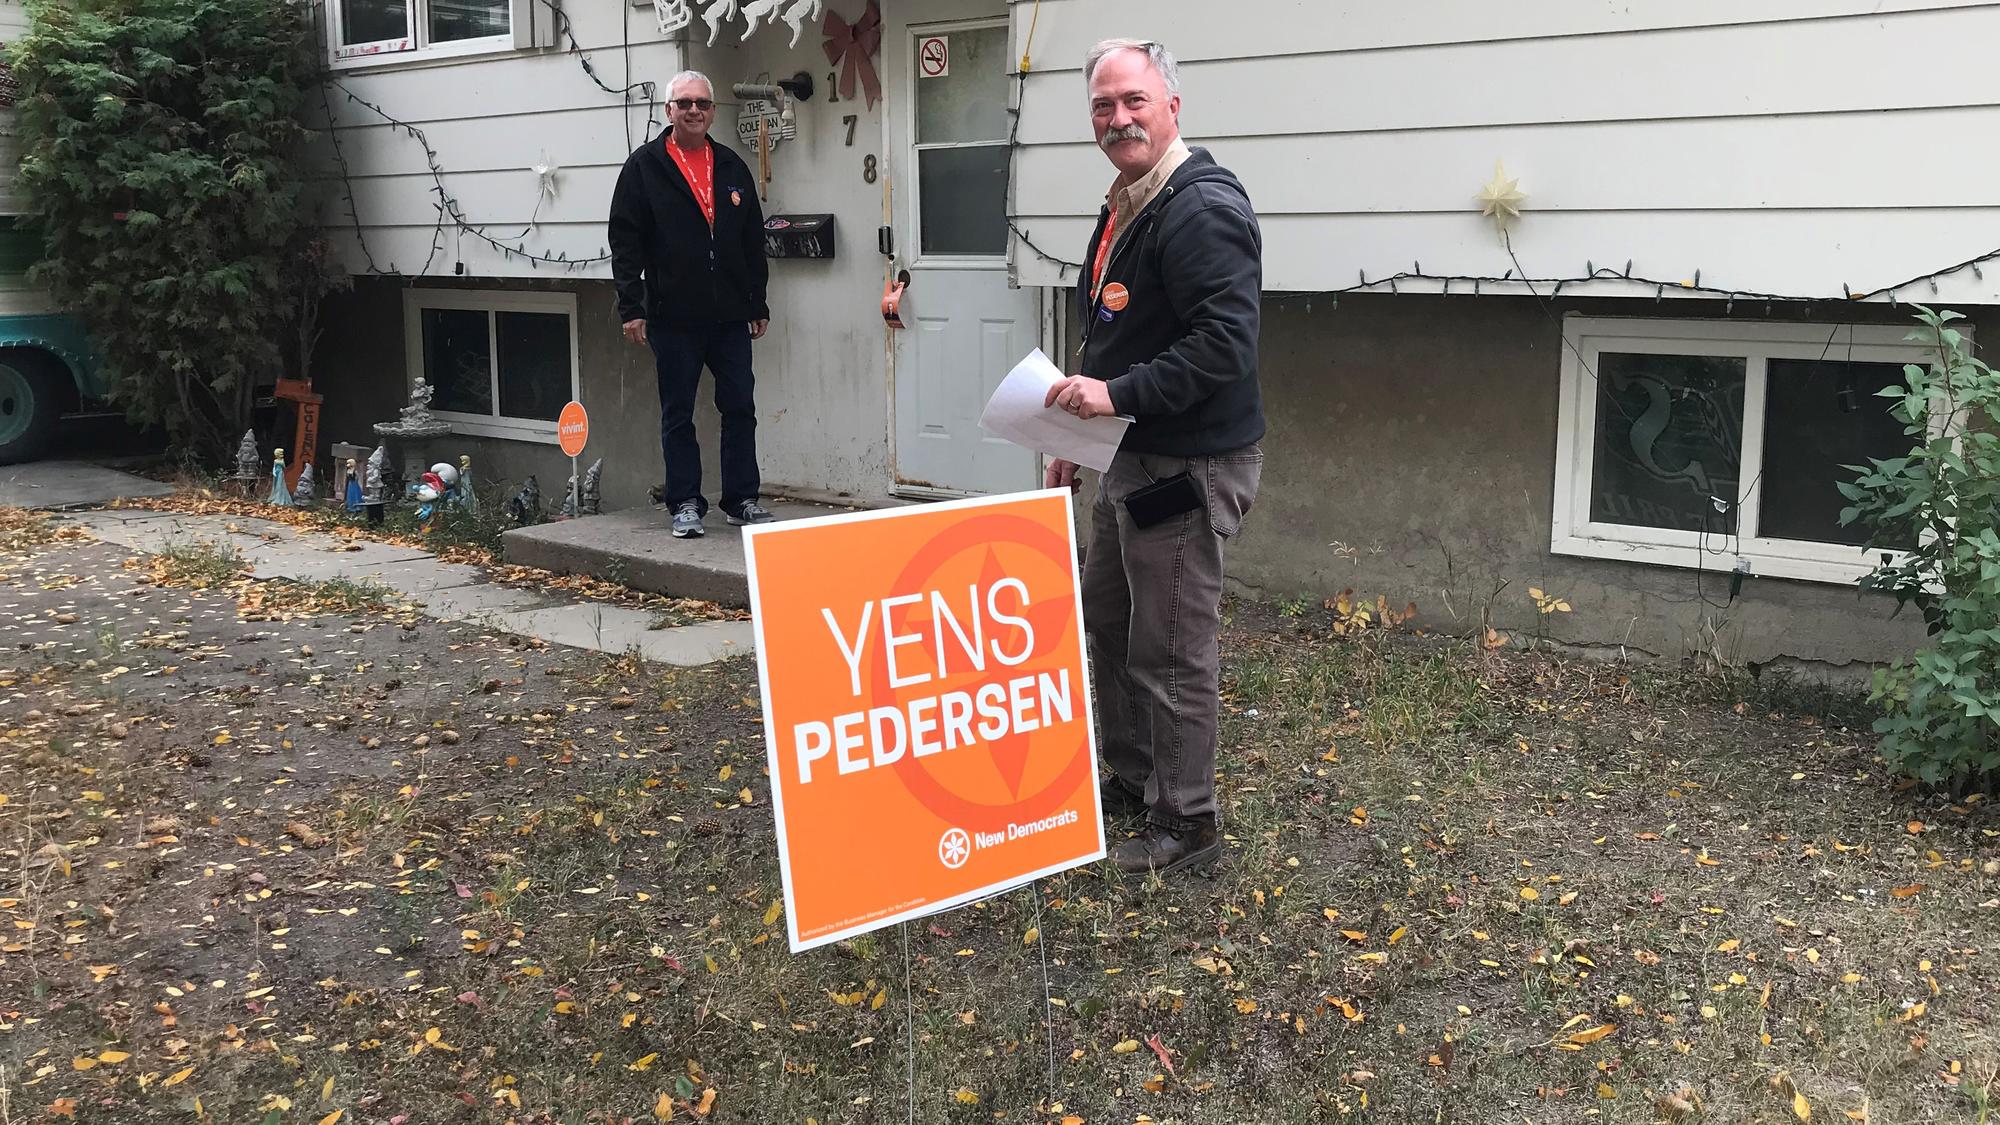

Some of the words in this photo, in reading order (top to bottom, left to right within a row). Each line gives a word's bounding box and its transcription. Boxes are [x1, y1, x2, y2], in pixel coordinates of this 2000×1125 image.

[740, 117, 778, 133] COLEAN
[747, 100, 765, 113] THE
[827, 72, 839, 102] 1
[842, 114, 857, 146] 7
[863, 154, 877, 184] 8
[750, 136, 775, 150] FAY
[303, 404, 314, 464] COLEMA
[821, 578, 1035, 696] YENS
[793, 668, 1073, 784] PEDERSEN
[975, 832, 1005, 850] New
[1007, 809, 1078, 841] Democrats
